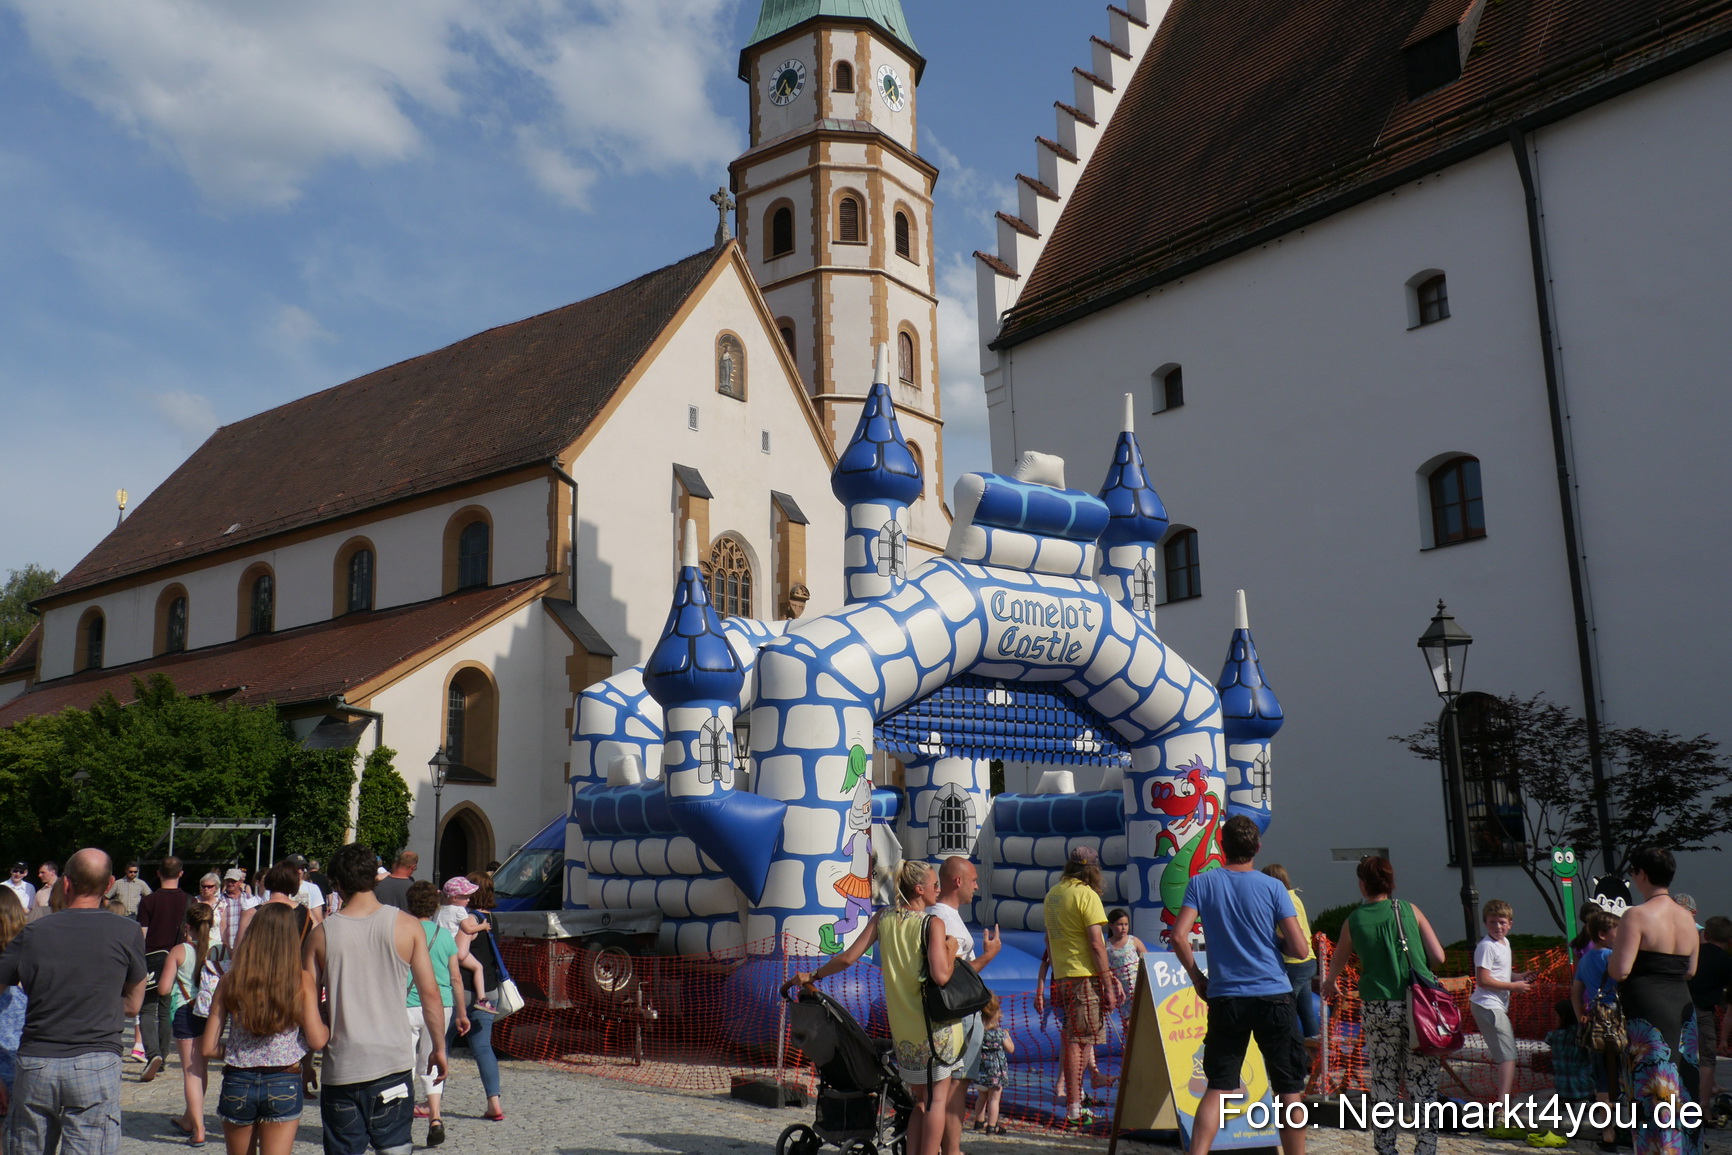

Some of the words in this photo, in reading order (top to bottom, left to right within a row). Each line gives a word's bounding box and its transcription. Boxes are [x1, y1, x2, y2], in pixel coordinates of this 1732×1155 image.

[990, 589, 1095, 632] Camelot
[997, 625, 1083, 663] Castle
[1165, 994, 1209, 1025] Sch
[1168, 1025, 1206, 1042] ausz
